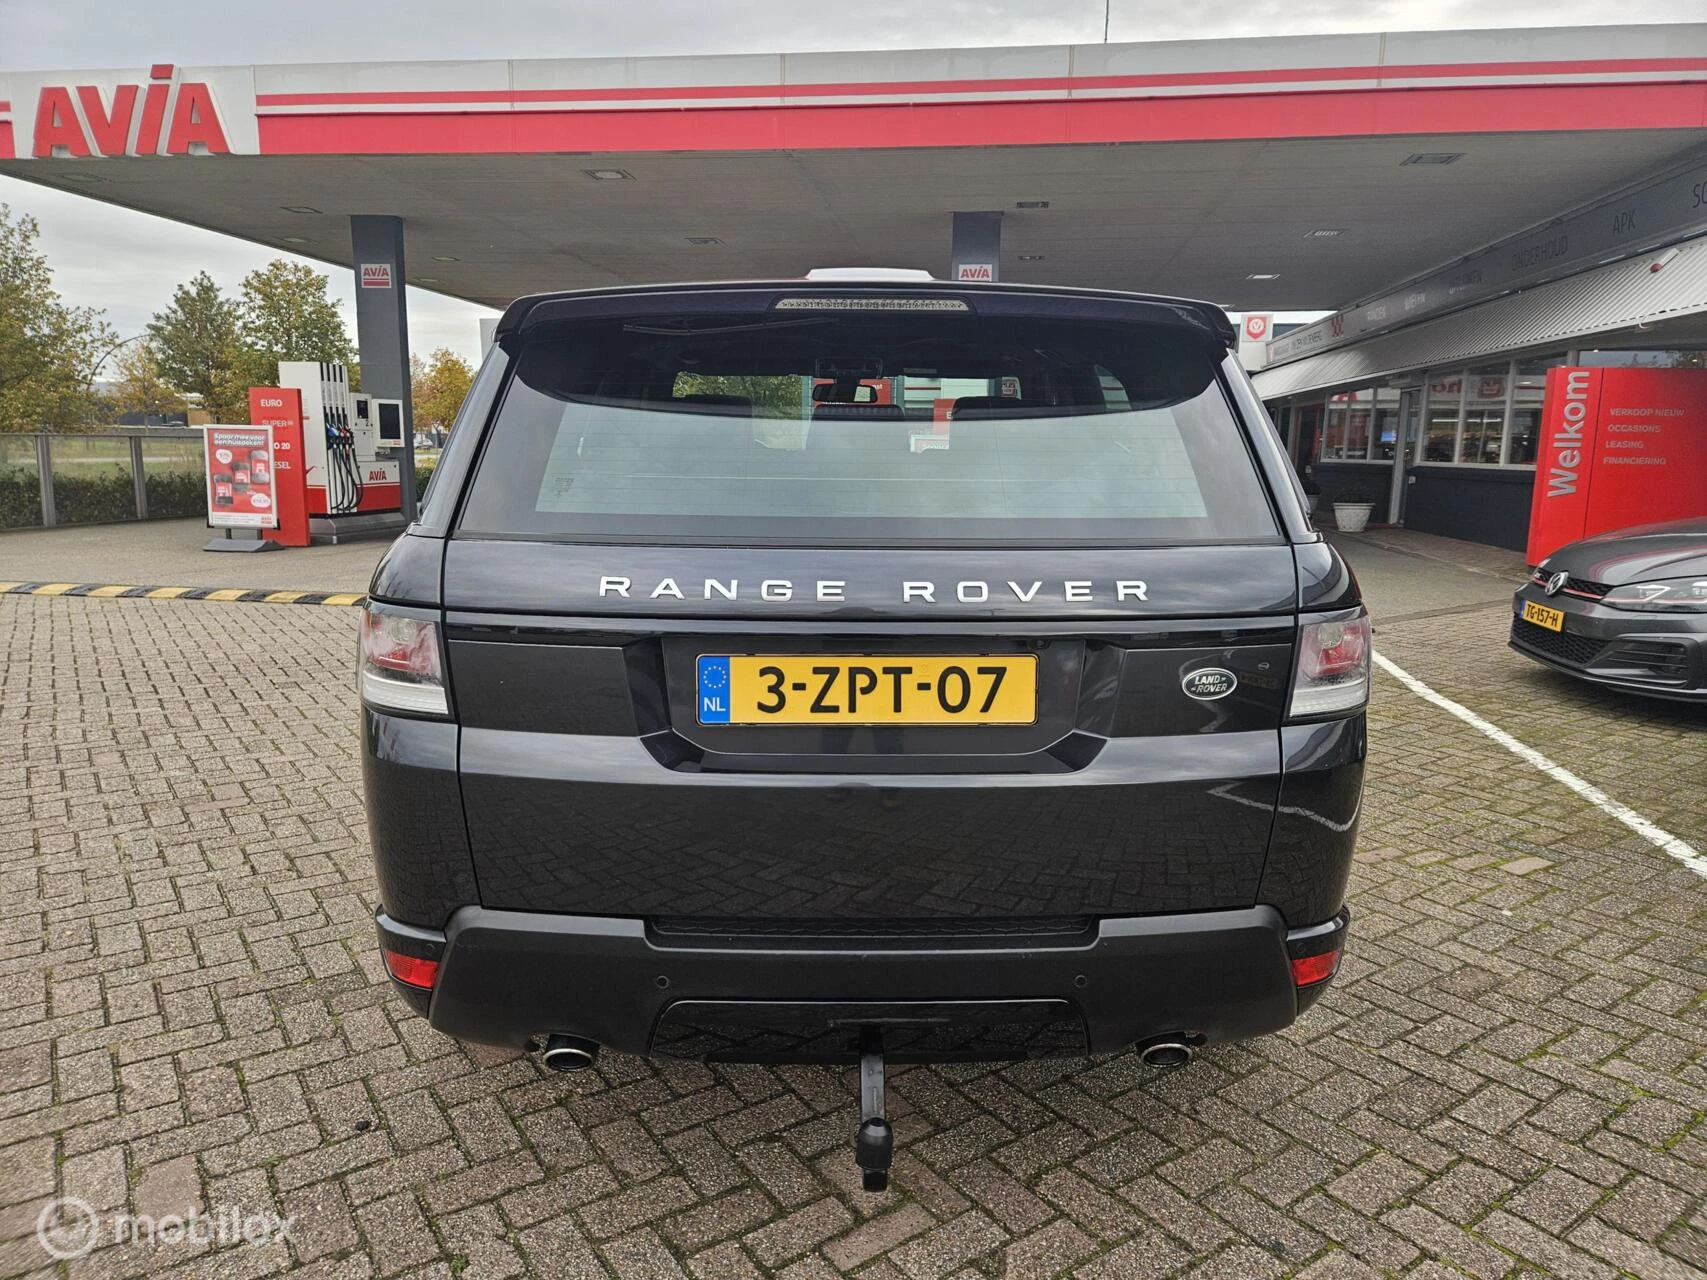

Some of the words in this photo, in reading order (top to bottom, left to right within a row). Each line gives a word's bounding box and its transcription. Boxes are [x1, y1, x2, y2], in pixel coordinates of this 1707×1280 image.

[1612, 208, 1636, 234] APK
[363, 265, 389, 277] AVIA
[960, 266, 990, 278] AVIA
[260, 399, 283, 407] EURO
[1610, 407, 1653, 416] VERKOOP
[1655, 408, 1685, 417] NIEUW
[1547, 371, 1590, 497] Welkom
[1608, 424, 1661, 433] OCCASIONS
[1605, 440, 1644, 449] LEASING
[1603, 456, 1666, 465] FINANCIERING
[369, 467, 387, 481] AVIA
[599, 576, 847, 604] RANGE
[902, 580, 1150, 604] ROVER
[1526, 604, 1559, 627] TG-157-H
[1194, 675, 1221, 685] LAND
[756, 665, 1009, 714] 3-ZPT-07
[1196, 683, 1228, 693] ROVER
[704, 697, 726, 712] NL
